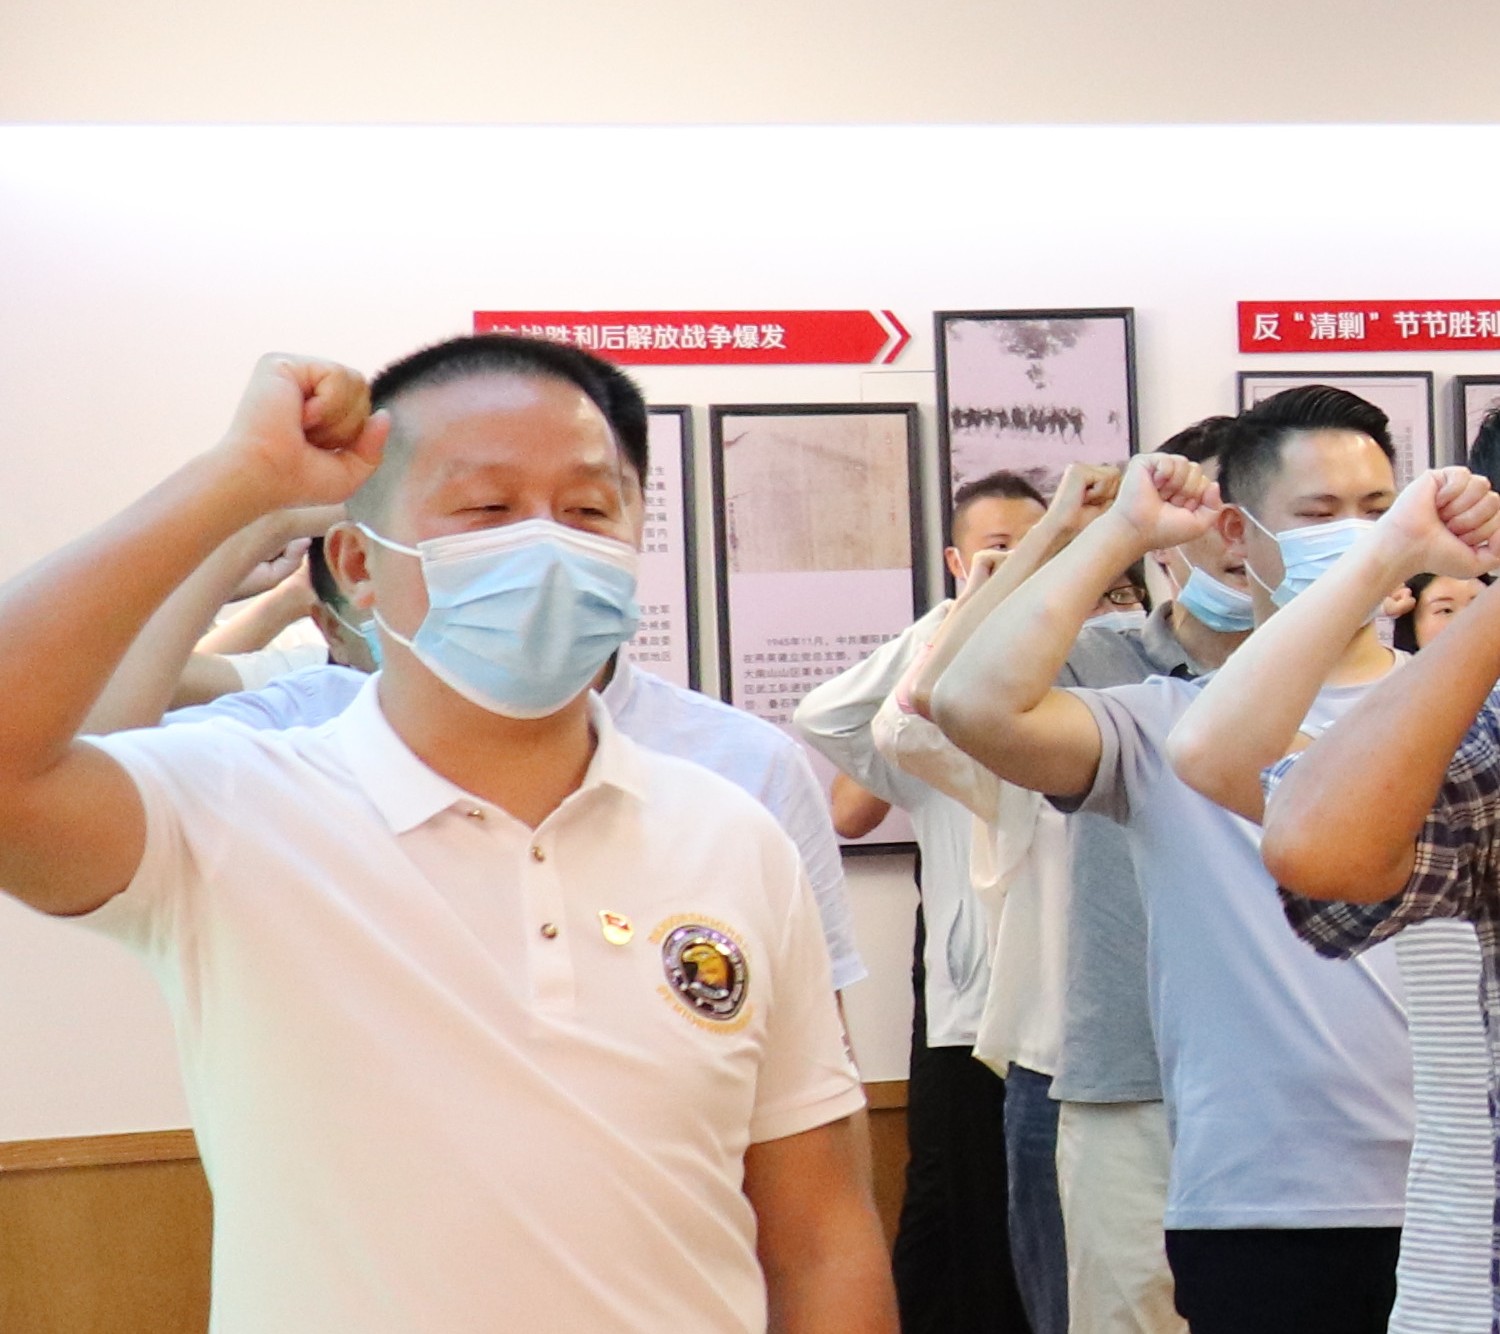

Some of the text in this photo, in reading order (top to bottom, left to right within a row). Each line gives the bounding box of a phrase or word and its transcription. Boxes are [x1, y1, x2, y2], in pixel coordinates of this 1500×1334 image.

[490, 324, 786, 350] 胜利后解放战争爆发
